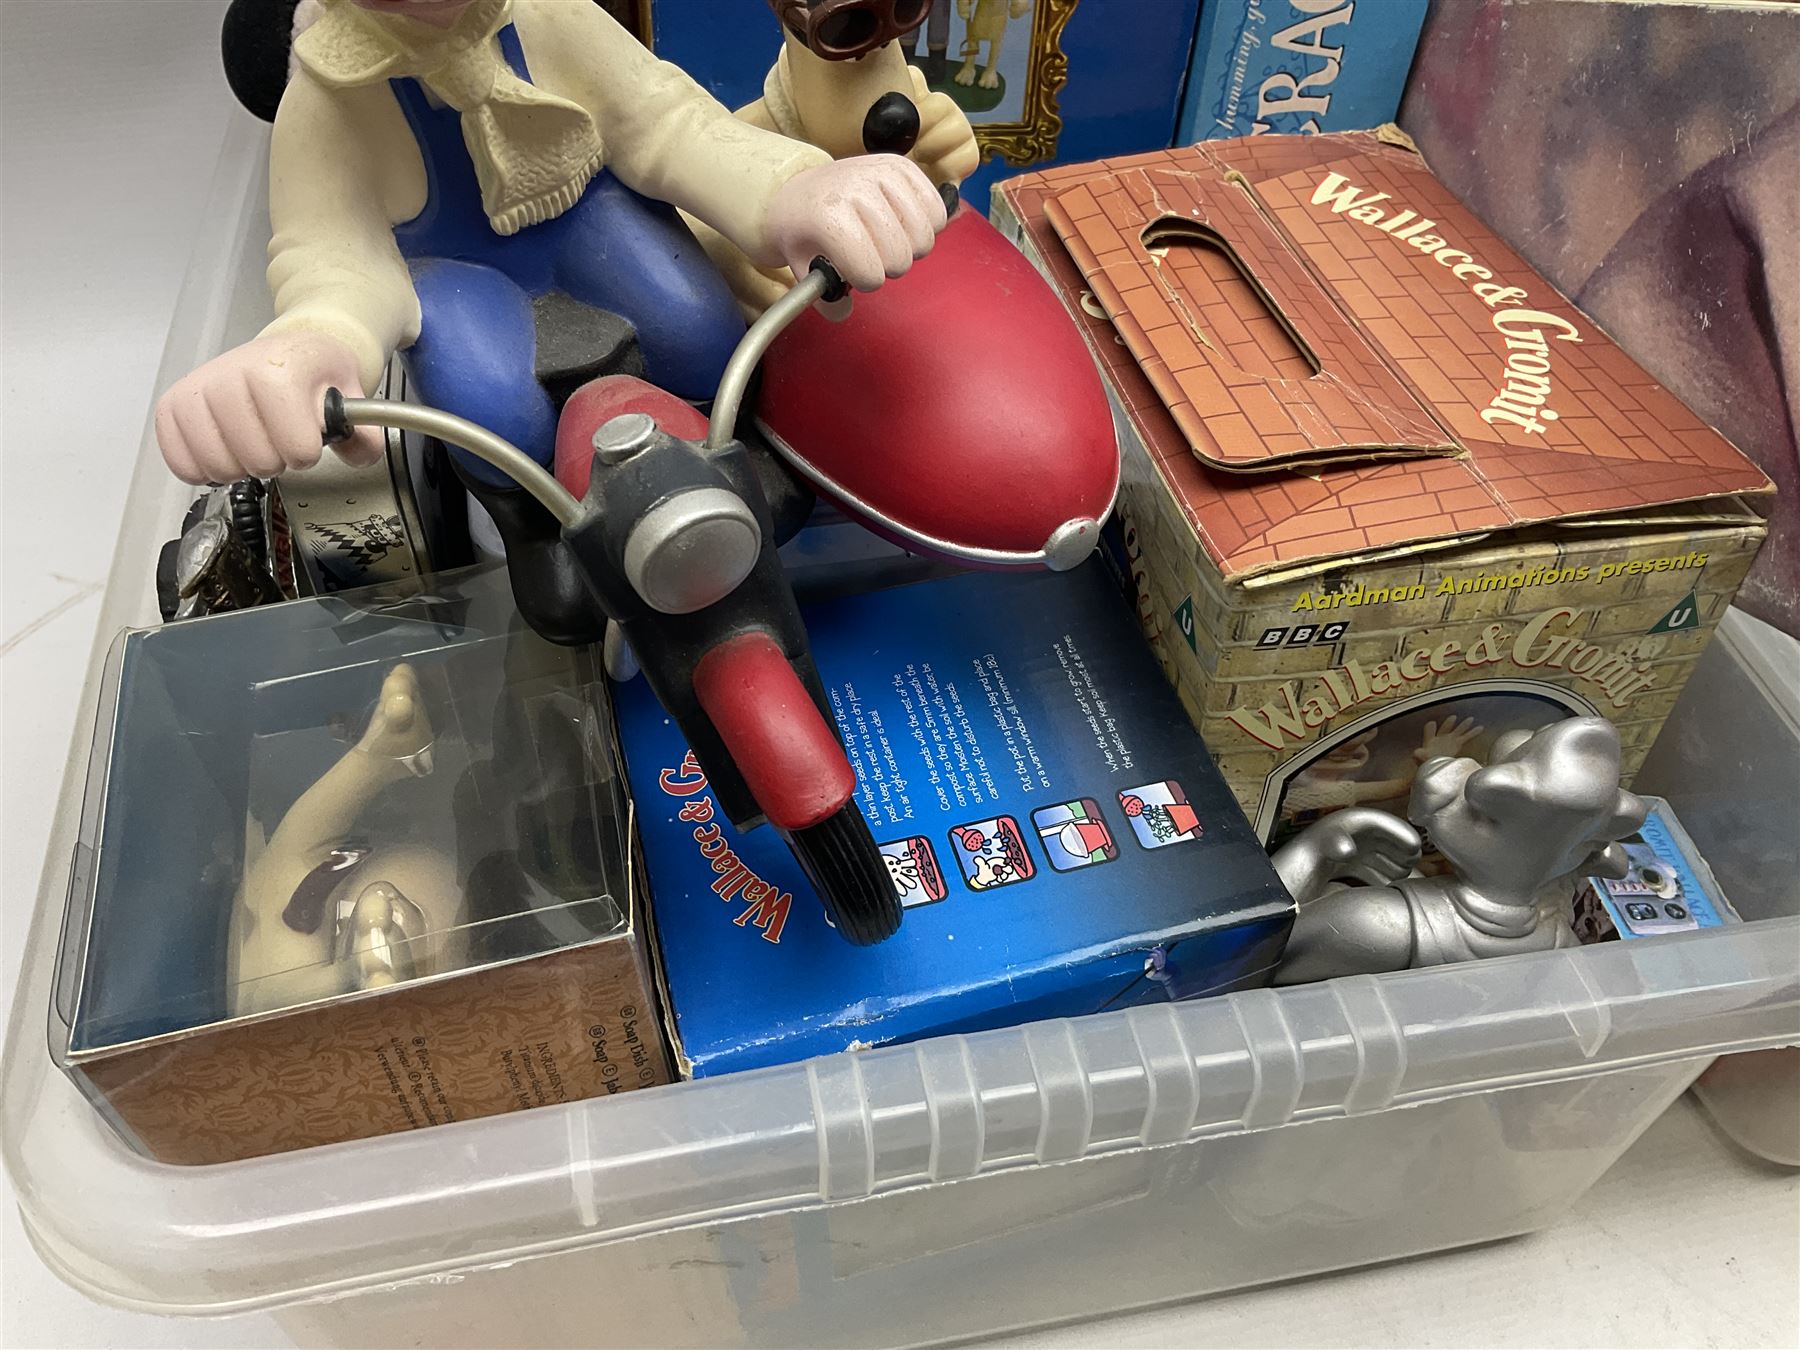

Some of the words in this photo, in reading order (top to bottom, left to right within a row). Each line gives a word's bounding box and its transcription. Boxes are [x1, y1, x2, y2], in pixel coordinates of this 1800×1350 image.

[1310, 172, 1493, 281] Wallace
[1473, 286, 1528, 307] &
[1479, 309, 1583, 434] Gromit
[1291, 584, 1425, 612] Aardman
[1436, 565, 1591, 596] Animations
[1597, 551, 1710, 584] presents
[1668, 607, 1692, 628] U
[1259, 622, 1347, 646] BBC
[1052, 643, 1068, 667] remove
[904, 663, 916, 676] the
[922, 663, 931, 672] be
[972, 658, 989, 677] place
[891, 673, 903, 686] the
[979, 677, 991, 691] and
[1224, 638, 1462, 751] Wallace
[1464, 623, 1512, 667] &
[1512, 607, 1658, 708] Gromit
[895, 688, 907, 696] of
[908, 677, 928, 706] beneath
[1074, 687, 1082, 696] to
[850, 702, 861, 715] dry
[900, 697, 913, 713] rest
[931, 695, 946, 712] with
[953, 703, 965, 717] the
[1076, 696, 1091, 714] start
[834, 708, 846, 721] the
[907, 713, 919, 727] the
[923, 706, 936, 727] 5mm
[993, 706, 1013, 730] plastic
[838, 723, 850, 731] of
[856, 716, 867, 733] safe
[945, 725, 957, 739] the
[959, 718, 976, 744] disturb
[1012, 716, 1031, 745] window
[1086, 715, 1101, 735] seeds
[845, 733, 857, 746] top
[911, 728, 926, 746] with
[931, 728, 941, 741] are
[1096, 735, 1107, 748] the
[1111, 732, 1131, 754] plastic
[850, 747, 858, 757] on
[865, 749, 878, 765] rest
[919, 746, 935, 768] seeds
[936, 743, 948, 760] they
[952, 740, 969, 771] Moisten
[971, 746, 980, 756] to
[1007, 745, 1025, 759] pot
[1027, 746, 1041, 769] warm
[944, 761, 953, 771] so
[974, 756, 987, 770] not
[1014, 760, 1027, 774] the
[1103, 749, 1118, 772] When
[1122, 755, 1133, 768] the
[851, 758, 866, 781] seeds
[871, 766, 883, 781] the
[928, 769, 940, 784] the
[945, 771, 966, 806] compost
[1020, 775, 1034, 792] Put
[1040, 776, 1050, 787] on
[861, 782, 874, 802] layer
[879, 782, 891, 802] keep
[935, 785, 950, 810] Cover
[679, 796, 714, 822] &
[866, 802, 879, 819] thin
[903, 805, 914, 818] An
[694, 823, 792, 944] Wallace
[591, 1040, 609, 1063] Soap
[623, 1020, 639, 1044] Soap
[631, 1043, 649, 1067] Dish
